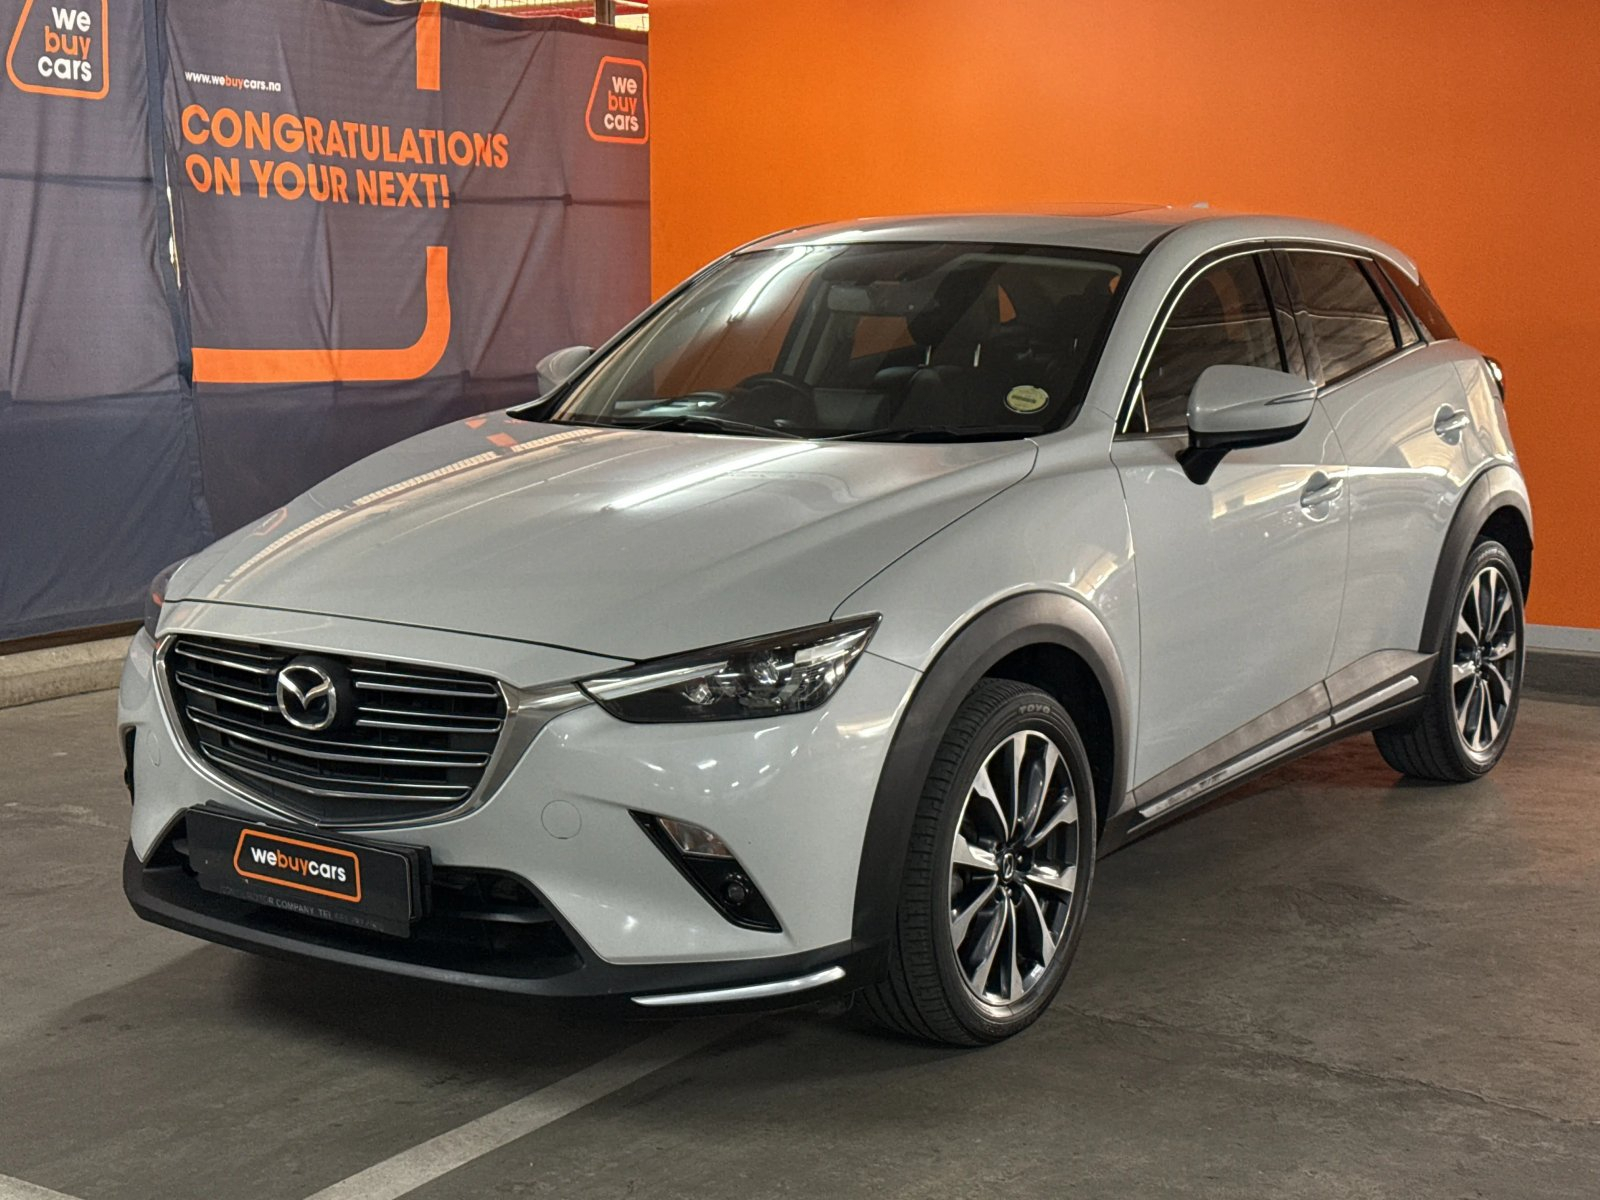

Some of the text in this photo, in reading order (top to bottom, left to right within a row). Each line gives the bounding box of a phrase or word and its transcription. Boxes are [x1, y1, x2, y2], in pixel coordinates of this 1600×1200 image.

[51, 6, 91, 32] we
[44, 25, 91, 60] buy
[37, 55, 92, 82] cars
[185, 71, 281, 92] www.webuycars.na
[612, 76, 637, 94] we
[608, 90, 637, 115] buy
[604, 113, 639, 132] cars
[181, 104, 509, 168] CONGRATULATIONS
[185, 153, 450, 209] ON YOUR NEXT!
[1019, 703, 1051, 715] TOYO
[250, 846, 347, 882] webuycars
